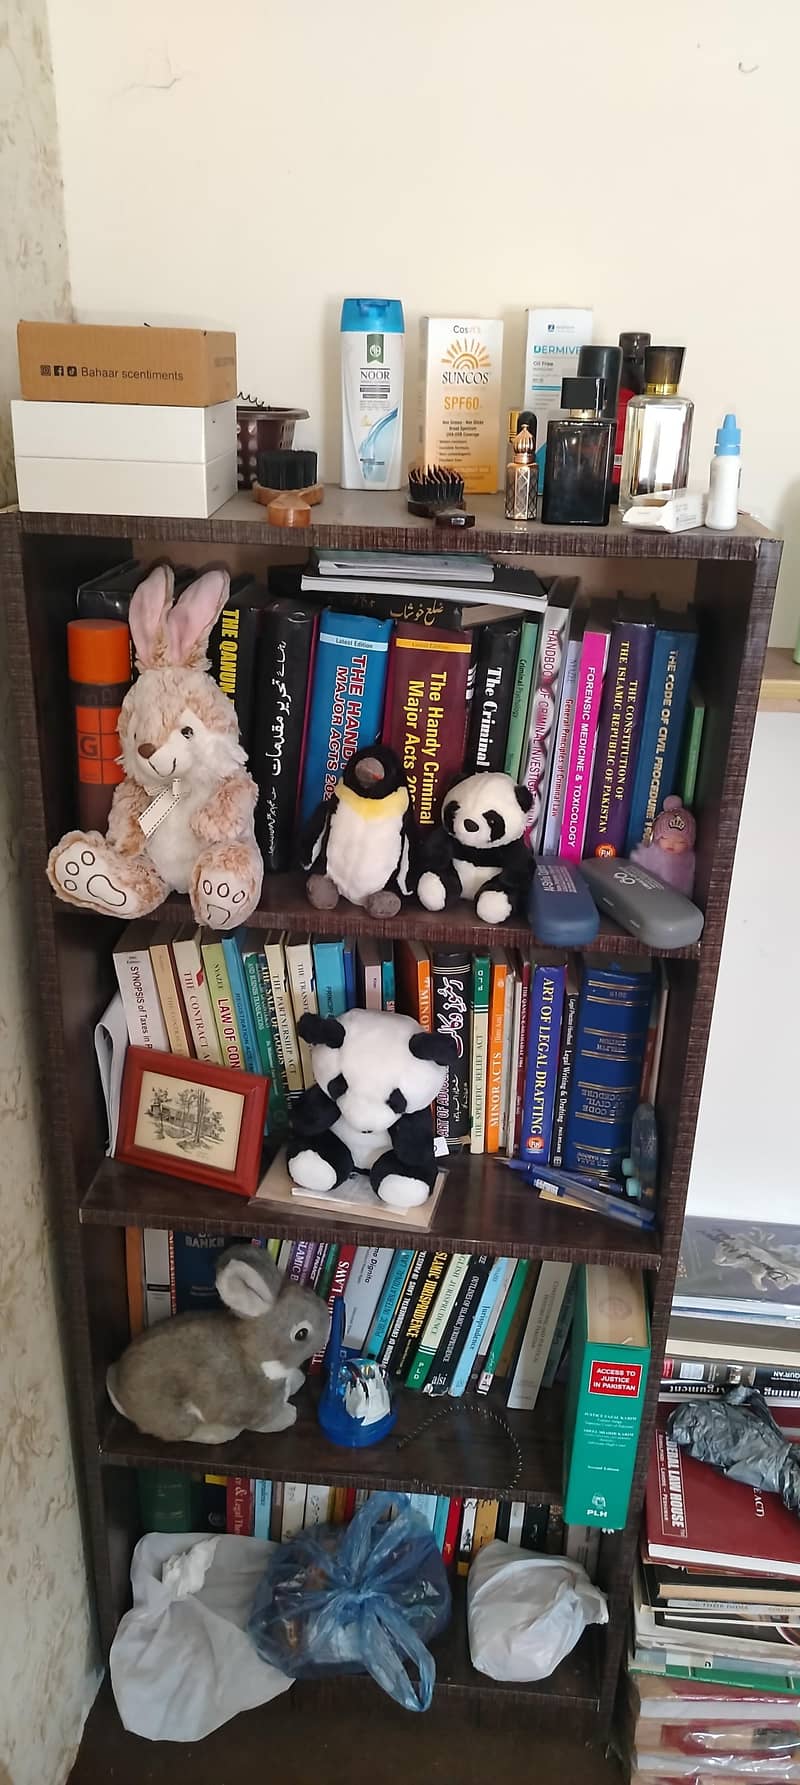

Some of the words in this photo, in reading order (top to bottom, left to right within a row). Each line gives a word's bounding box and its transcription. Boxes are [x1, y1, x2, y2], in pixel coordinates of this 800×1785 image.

[81, 366, 119, 378] Bahaar
[121, 367, 184, 381] scentiments
[360, 371, 390, 380] NOOR
[442, 371, 489, 385] SUNCOS
[444, 396, 479, 410] SPF60
[222, 609, 239, 638] THE
[353, 640, 373, 648] Edition
[620, 640, 630, 663] THE
[219, 640, 238, 694] QANUN
[349, 654, 367, 696] THE
[430, 672, 447, 702] The
[485, 667, 503, 696] The
[582, 666, 595, 722] FORENSIC
[613, 666, 629, 710] ISLAMIC
[630, 680, 638, 702] THE
[662, 673, 674, 706] CODE
[332, 666, 348, 726] MAJOR
[403, 680, 425, 730] Major
[659, 708, 669, 725] OF
[79, 736, 98, 757] G
[341, 700, 362, 769] HAND
[421, 707, 444, 758] Handy
[477, 700, 498, 766] Criminal
[607, 712, 622, 764] REPUBLIC
[617, 704, 637, 785] CONSTITUTION
[655, 727, 668, 755] CIVIL
[327, 727, 342, 770] ACTS
[403, 733, 420, 770] Acts
[577, 724, 590, 773] MEDICINE
[575, 774, 583, 782] &
[604, 767, 613, 782] OF
[419, 761, 440, 825] Criminal
[615, 786, 624, 801] OF
[647, 757, 665, 821] PROCEDURE
[567, 782, 583, 849] TOXICOLOGY
[598, 784, 612, 833] PAKISTAN
[272, 975, 281, 991] THE
[297, 962, 305, 977] THE
[131, 966, 145, 1003] SYNOPSIS
[541, 977, 555, 1002] ART
[138, 1003, 145, 1012] of
[184, 971, 195, 989] THE
[190, 995, 209, 1048] CONTRACT
[218, 998, 232, 1024] LAW
[266, 988, 276, 1013] SALE
[271, 1016, 278, 1030] OF
[540, 1003, 552, 1023] OF
[140, 1012, 149, 1034] Taxes
[224, 1027, 236, 1042] OF
[276, 996, 293, 1056] PARTNERSHIP
[144, 1034, 152, 1042] in
[475, 1034, 484, 1050] ACT
[535, 1024, 551, 1069] LEGAL
[287, 1059, 297, 1074] ACT
[475, 1055, 483, 1081] RELIEF
[492, 1052, 502, 1084] ACTS
[563, 1049, 573, 1065] Legal
[560, 1066, 571, 1089] Writing
[437, 1106, 449, 1120] OF
[491, 1086, 501, 1127] MINOR
[530, 1071, 547, 1134] DRAFTING
[556, 1097, 567, 1122] Drafting
[437, 1120, 449, 1137] ART
[474, 1125, 482, 1137] THE
[331, 1260, 350, 1293] LAWS
[405, 1280, 417, 1297] LAWS
[414, 1250, 427, 1273] PAKISTA
[427, 1251, 448, 1279] SLAMIC
[406, 1279, 438, 1338] JURISPRUDENCE
[431, 1281, 457, 1334] JURISPRUDENCE
[470, 1305, 491, 1350] Jurisprudence
[596, 1368, 624, 1376] ACCESS
[600, 1375, 630, 1384] JUSTICE
[602, 1382, 636, 1391] PAKISTAN
[235, 1486, 248, 1496] &
[668, 1471, 681, 1494] LAW
[586, 1509, 608, 1517] PLH
[670, 1494, 685, 1528] HOUSE
